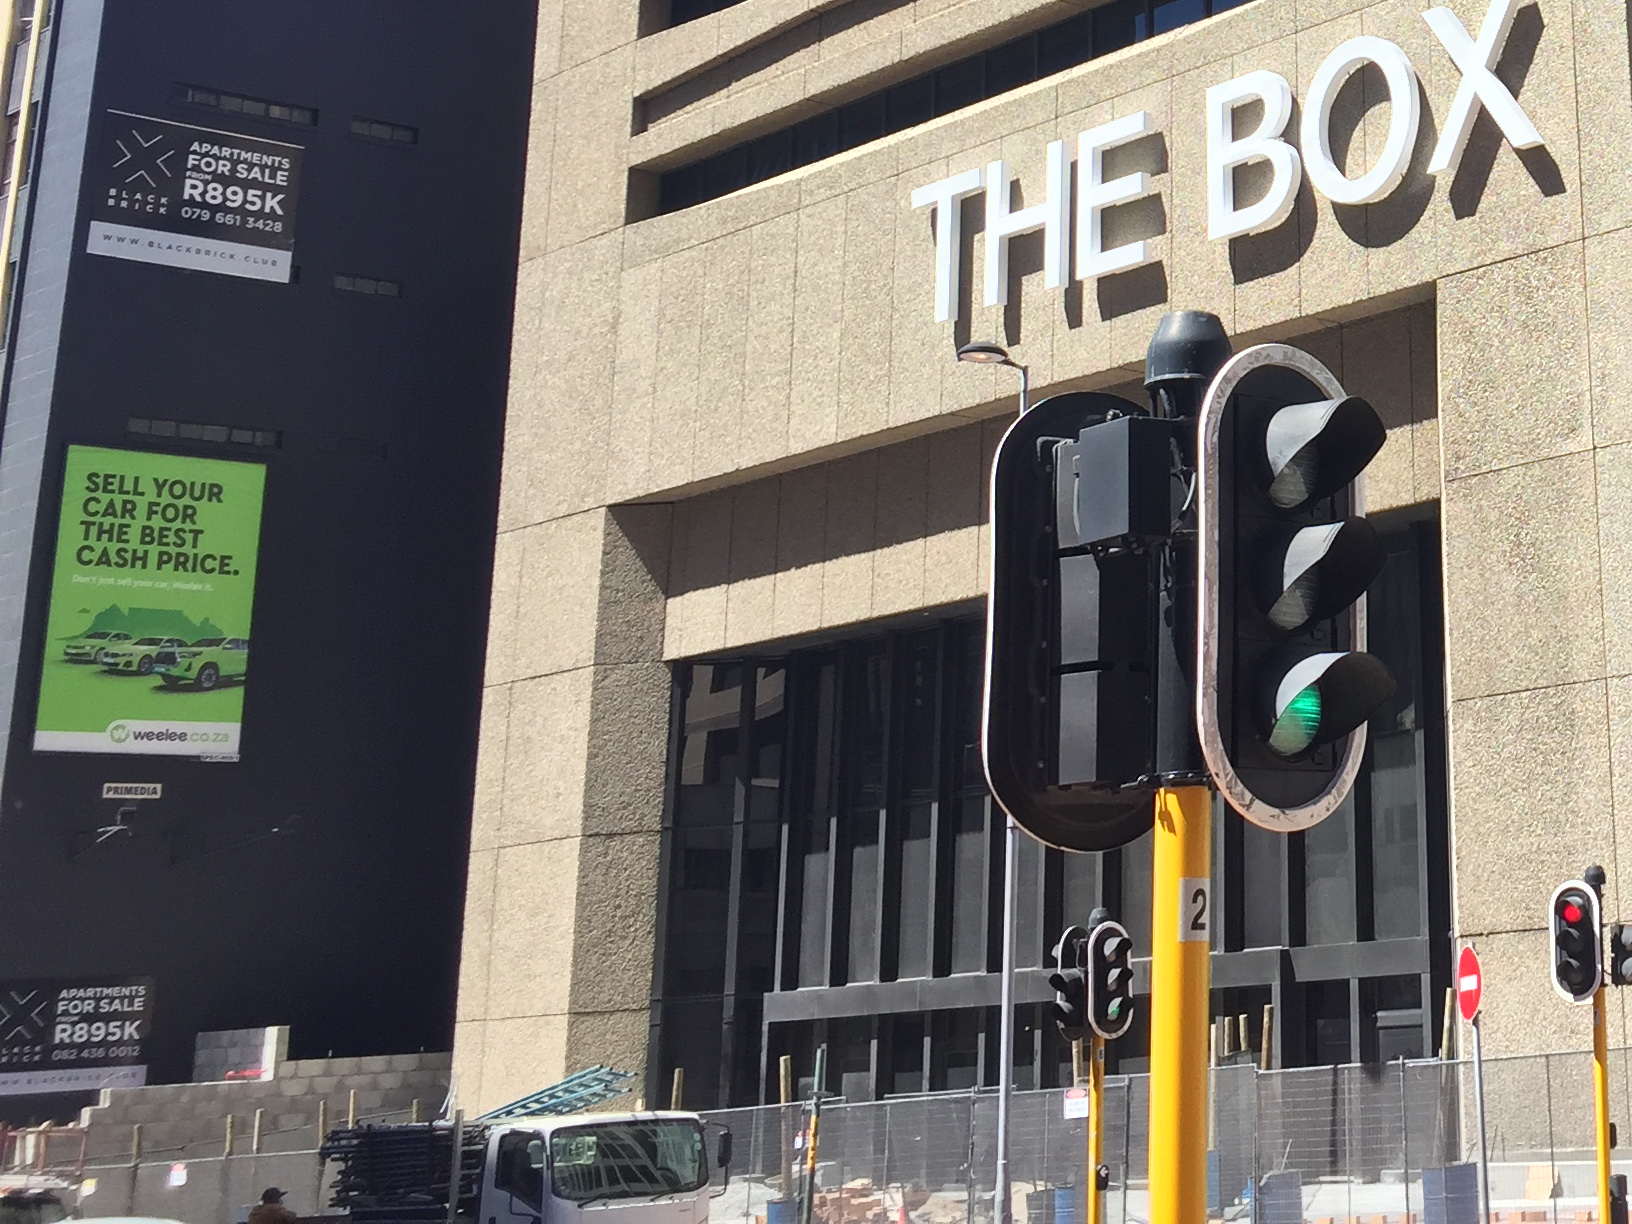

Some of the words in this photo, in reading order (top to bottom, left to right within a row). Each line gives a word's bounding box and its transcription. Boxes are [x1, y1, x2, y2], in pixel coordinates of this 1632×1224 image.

[189, 141, 290, 169] APARTMENTS
[185, 171, 212, 182] FROM
[187, 154, 231, 176] FOR
[235, 163, 289, 186] SALE
[107, 198, 167, 215] BRICK
[109, 188, 169, 205] BLACK
[183, 178, 286, 215] R895K
[181, 207, 210, 221] 079
[215, 212, 241, 226] 661
[245, 217, 283, 233] 3428
[911, 109, 1154, 323] THE
[85, 472, 145, 497] SELL
[153, 477, 223, 503] YOUR
[82, 496, 137, 521] CAR
[146, 501, 197, 525] FOR
[79, 520, 132, 544] THE
[140, 525, 204, 549] BEST
[76, 545, 149, 569] CASH
[156, 550, 239, 576] PRICE.
[105, 785, 158, 796] PRIMEDIA
[1190, 887, 1207, 931] 2
[56, 999, 95, 1015] FOR
[99, 997, 145, 1013] SALE
[58, 986, 146, 999] APARTMENTS
[54, 1019, 142, 1044] R895K
